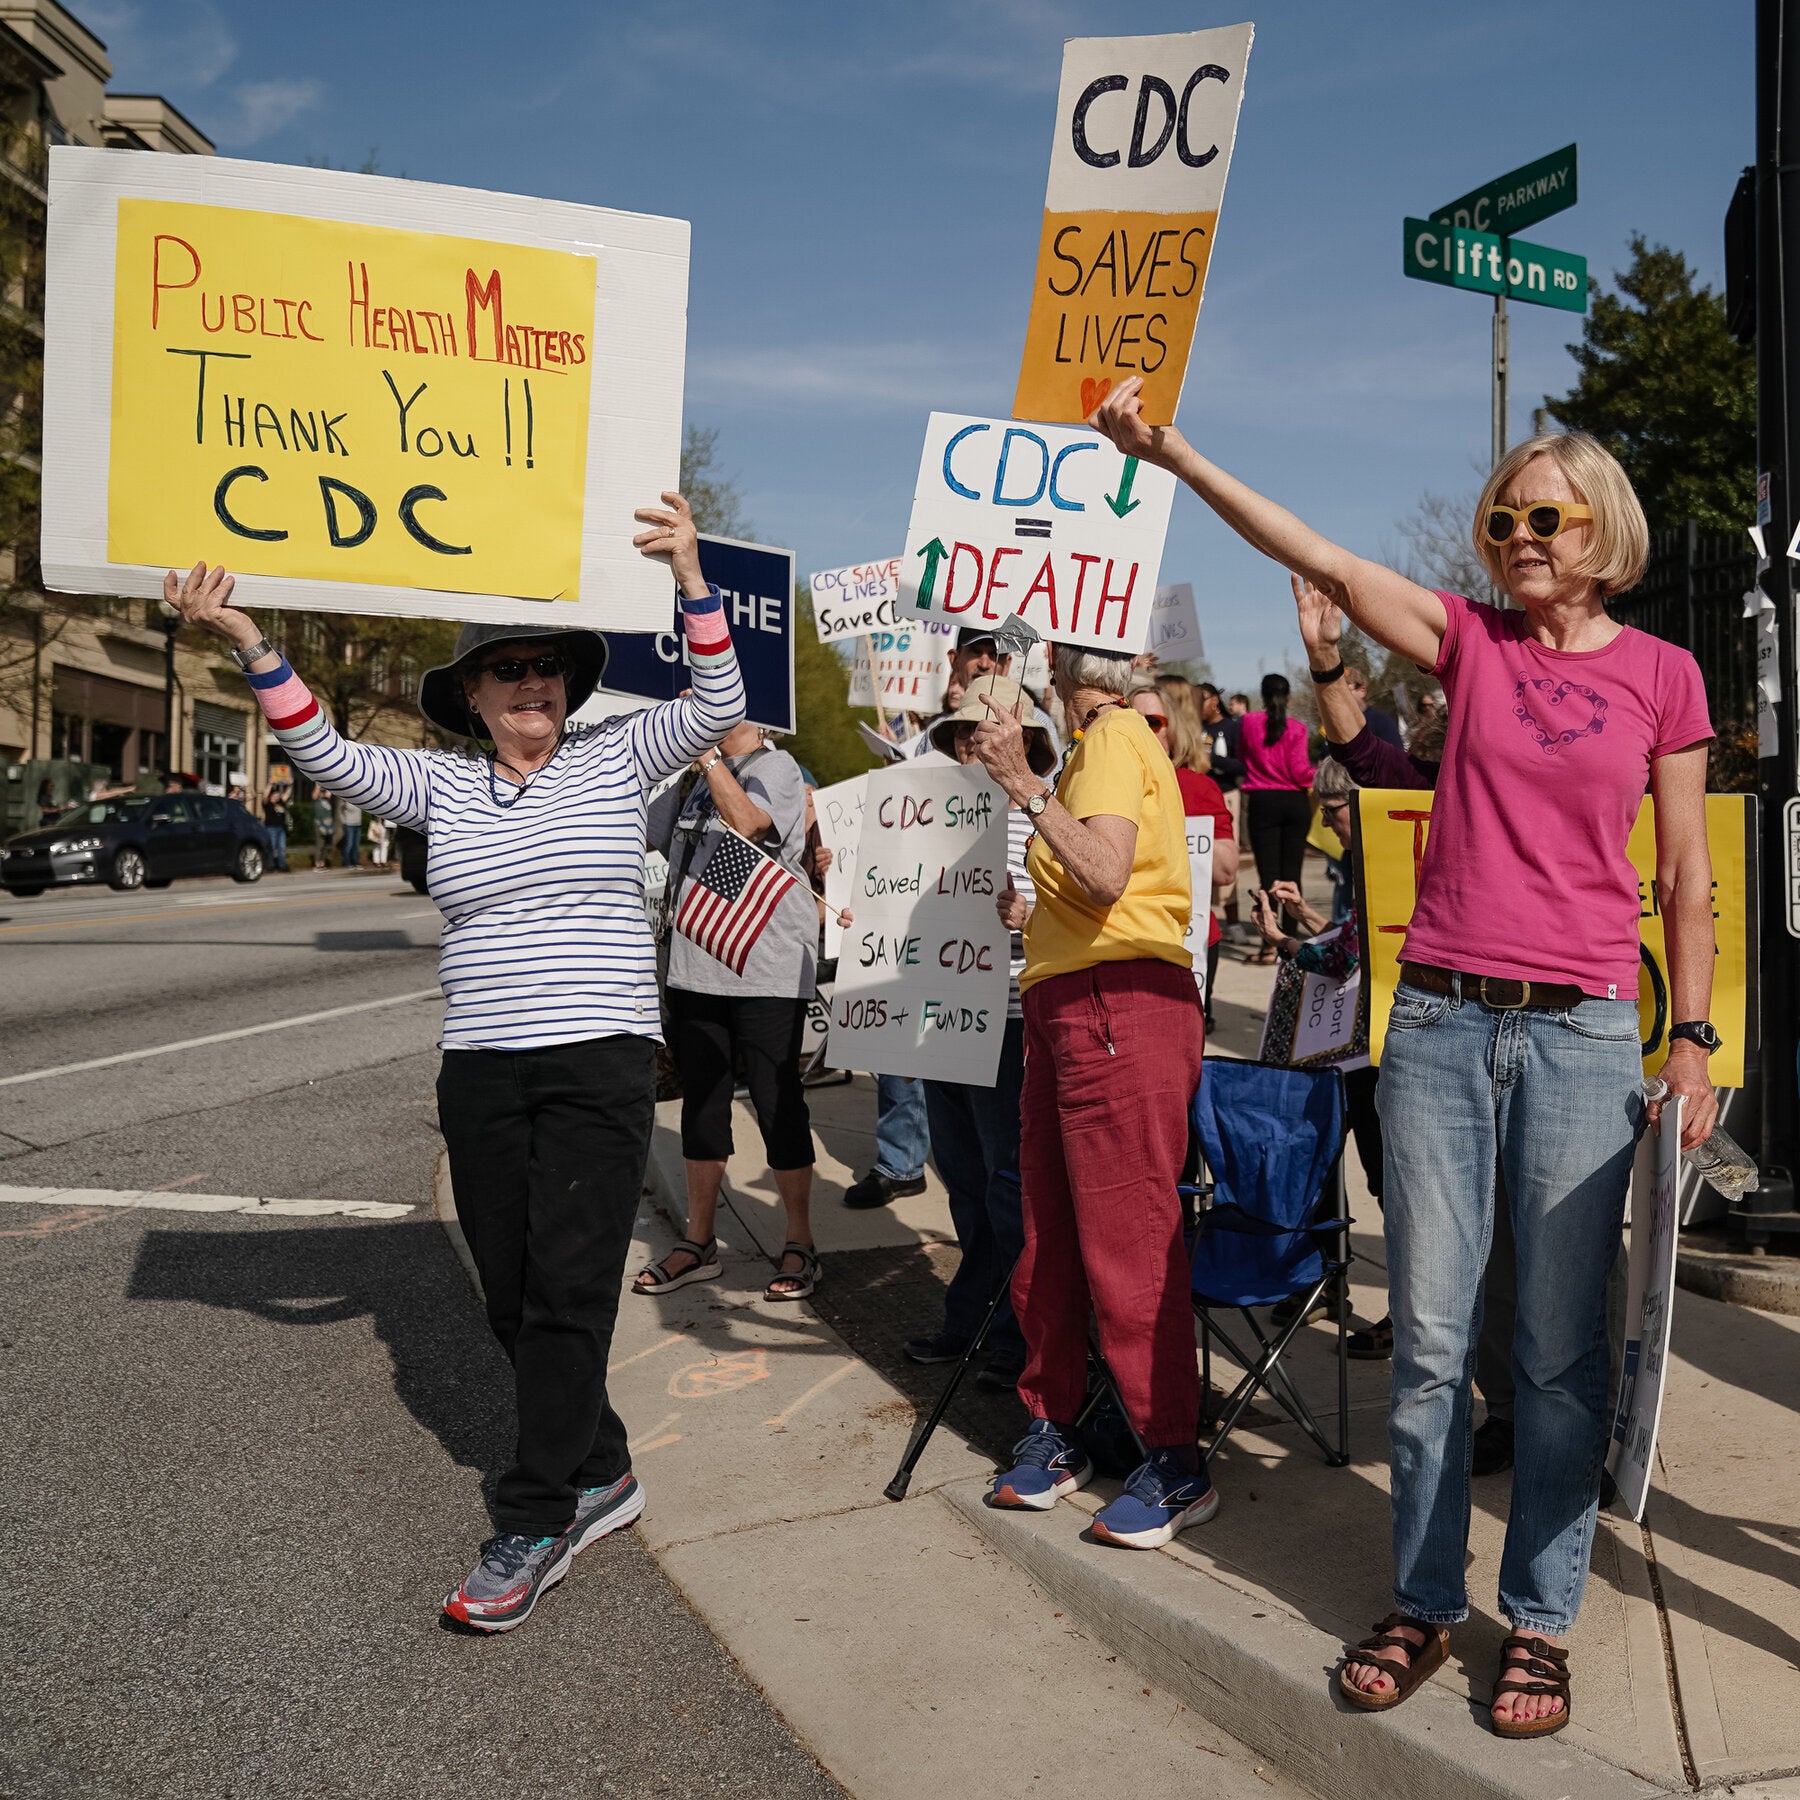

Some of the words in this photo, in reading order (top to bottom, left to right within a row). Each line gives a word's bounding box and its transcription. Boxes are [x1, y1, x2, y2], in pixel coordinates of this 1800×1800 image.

[1072, 64, 1230, 168] CDC
[1439, 197, 1491, 232] DC
[1497, 167, 1569, 216] PARKWAY
[1048, 226, 1206, 297] SAVES
[1415, 232, 1546, 292] Clifton
[1553, 268, 1578, 291] RD
[348, 261, 458, 358] HEALTH
[466, 269, 587, 374] MATTERS
[1055, 313, 1168, 373] LIVES
[166, 347, 350, 457] THANK
[942, 424, 1099, 512] CDC
[213, 464, 472, 556] CDC
[813, 570, 849, 592] CDC
[852, 559, 903, 584] SAVE
[842, 579, 888, 602] LIVES
[943, 541, 1139, 639] DEATH
[819, 608, 873, 636] Save
[878, 796, 934, 831] CDC
[945, 792, 993, 833] Staff
[864, 863, 923, 899] Saved
[936, 866, 995, 896] LIVES
[860, 932, 921, 967] SAVE
[939, 938, 993, 975] CDC
[839, 998, 887, 1030] JOBS
[1309, 983, 1327, 1029] CDC
